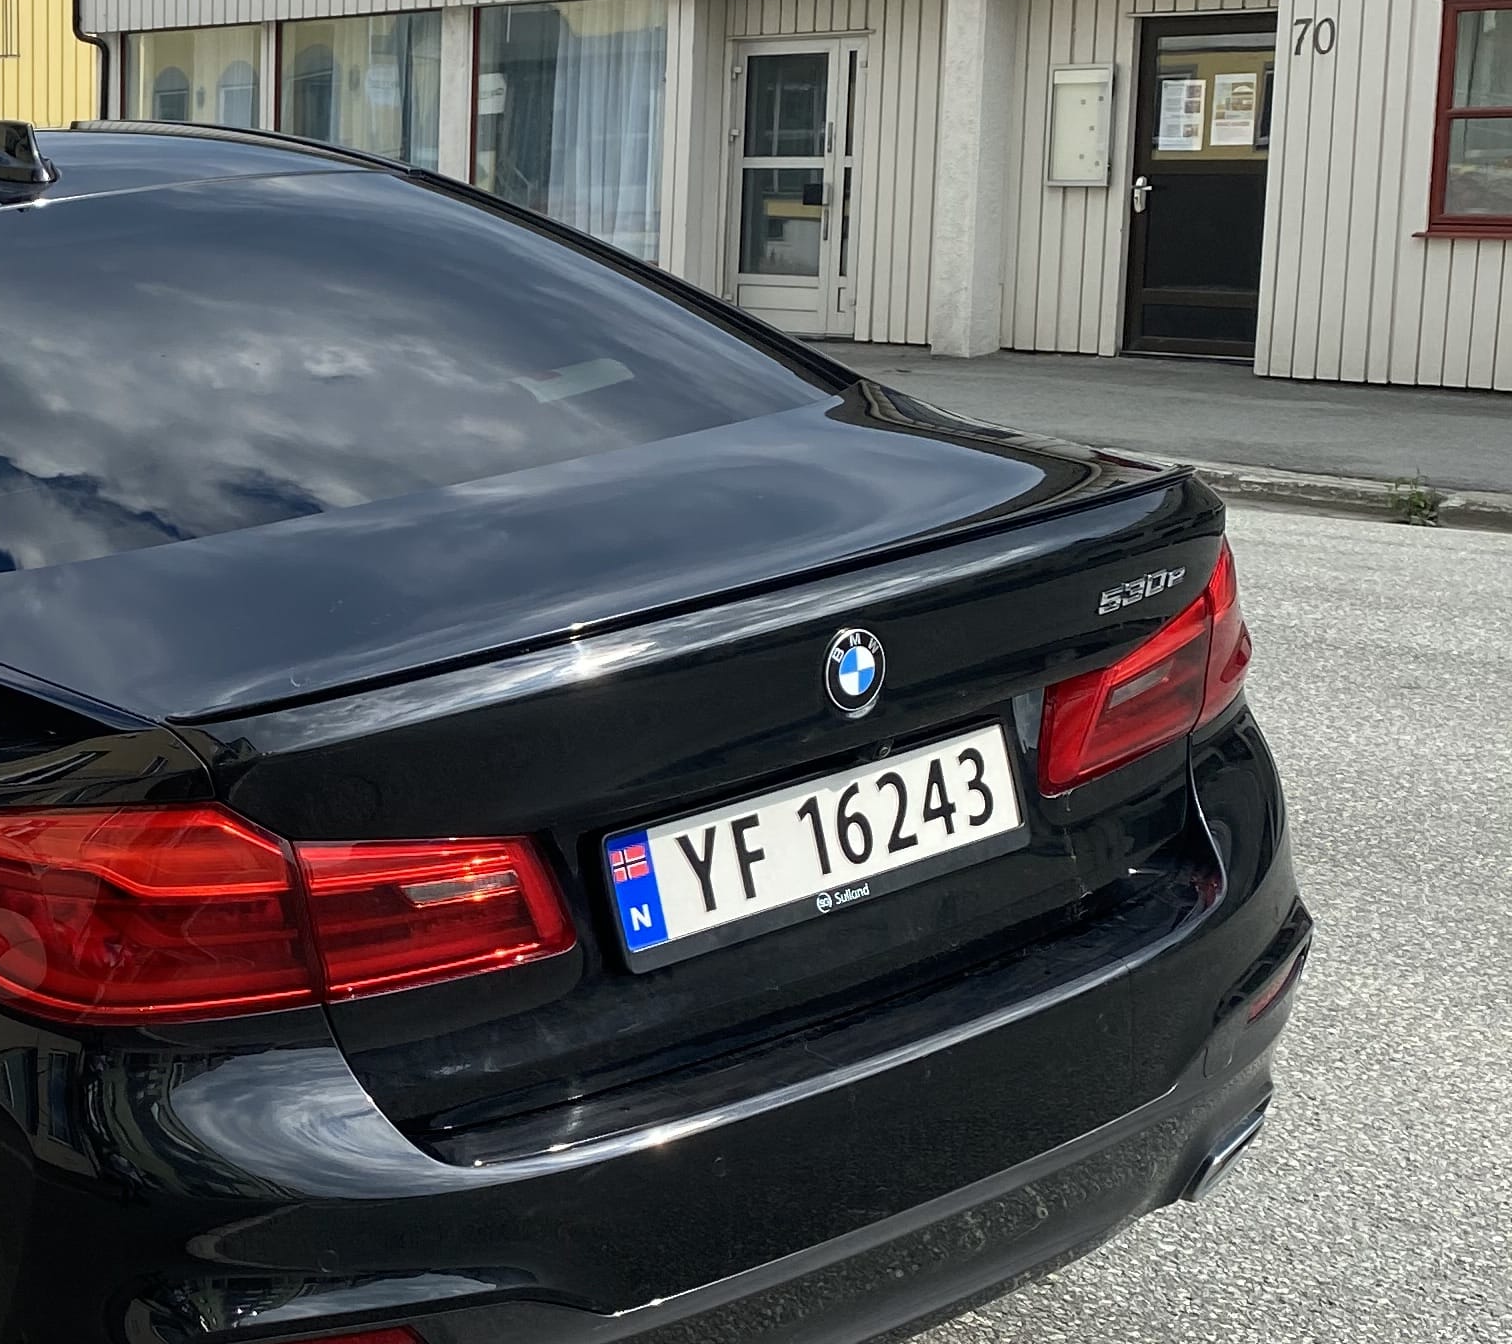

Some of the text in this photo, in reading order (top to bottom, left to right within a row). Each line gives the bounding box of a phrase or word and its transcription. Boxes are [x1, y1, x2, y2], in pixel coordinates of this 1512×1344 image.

[1294, 17, 1336, 56] 70
[831, 632, 880, 664] BMW
[676, 747, 995, 912] YF 16243
[834, 882, 870, 905] Sulland
[630, 904, 653, 931] N
